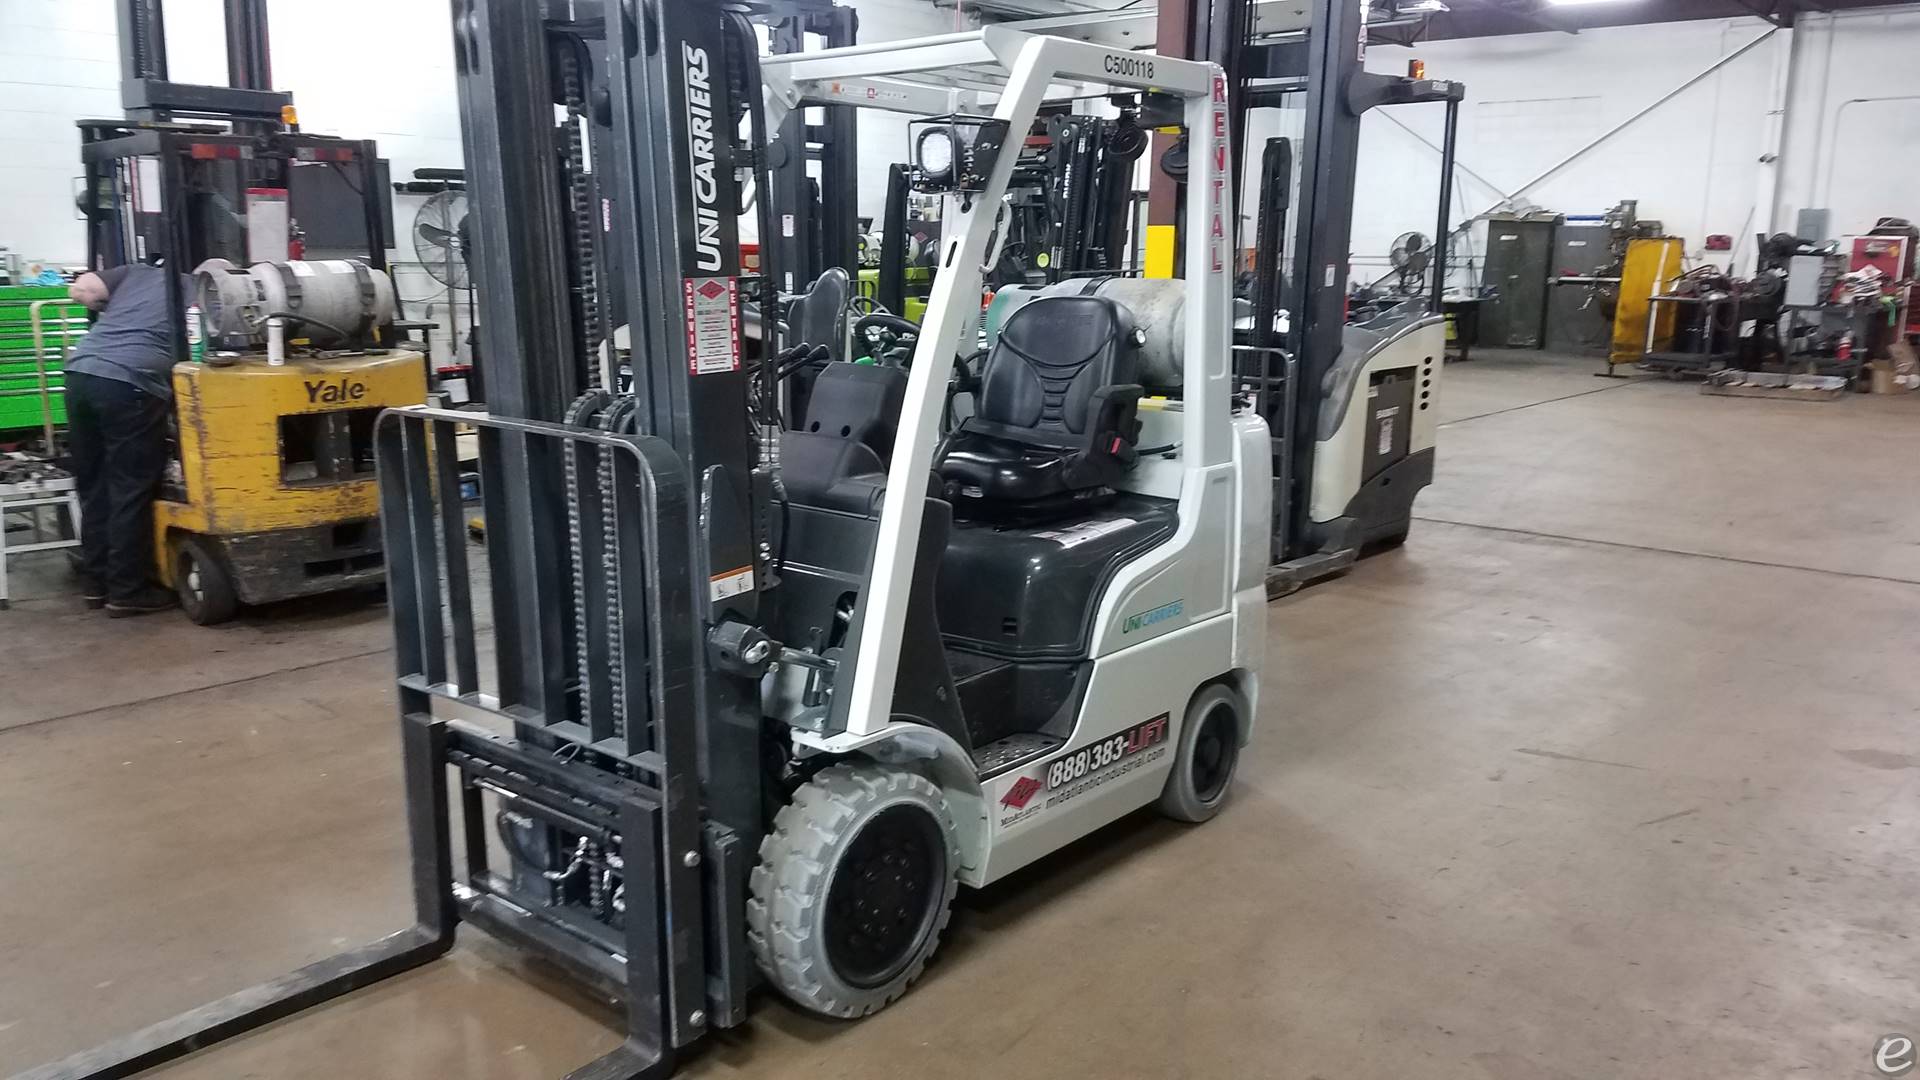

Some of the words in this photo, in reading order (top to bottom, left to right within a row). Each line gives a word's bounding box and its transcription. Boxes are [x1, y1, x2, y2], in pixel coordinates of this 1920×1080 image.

[1104, 54, 1154, 79] C500118
[1211, 75, 1226, 273] RENTAL
[685, 282, 697, 370] SERVICE
[729, 280, 740, 366] RENTALS
[304, 379, 365, 403] Yale
